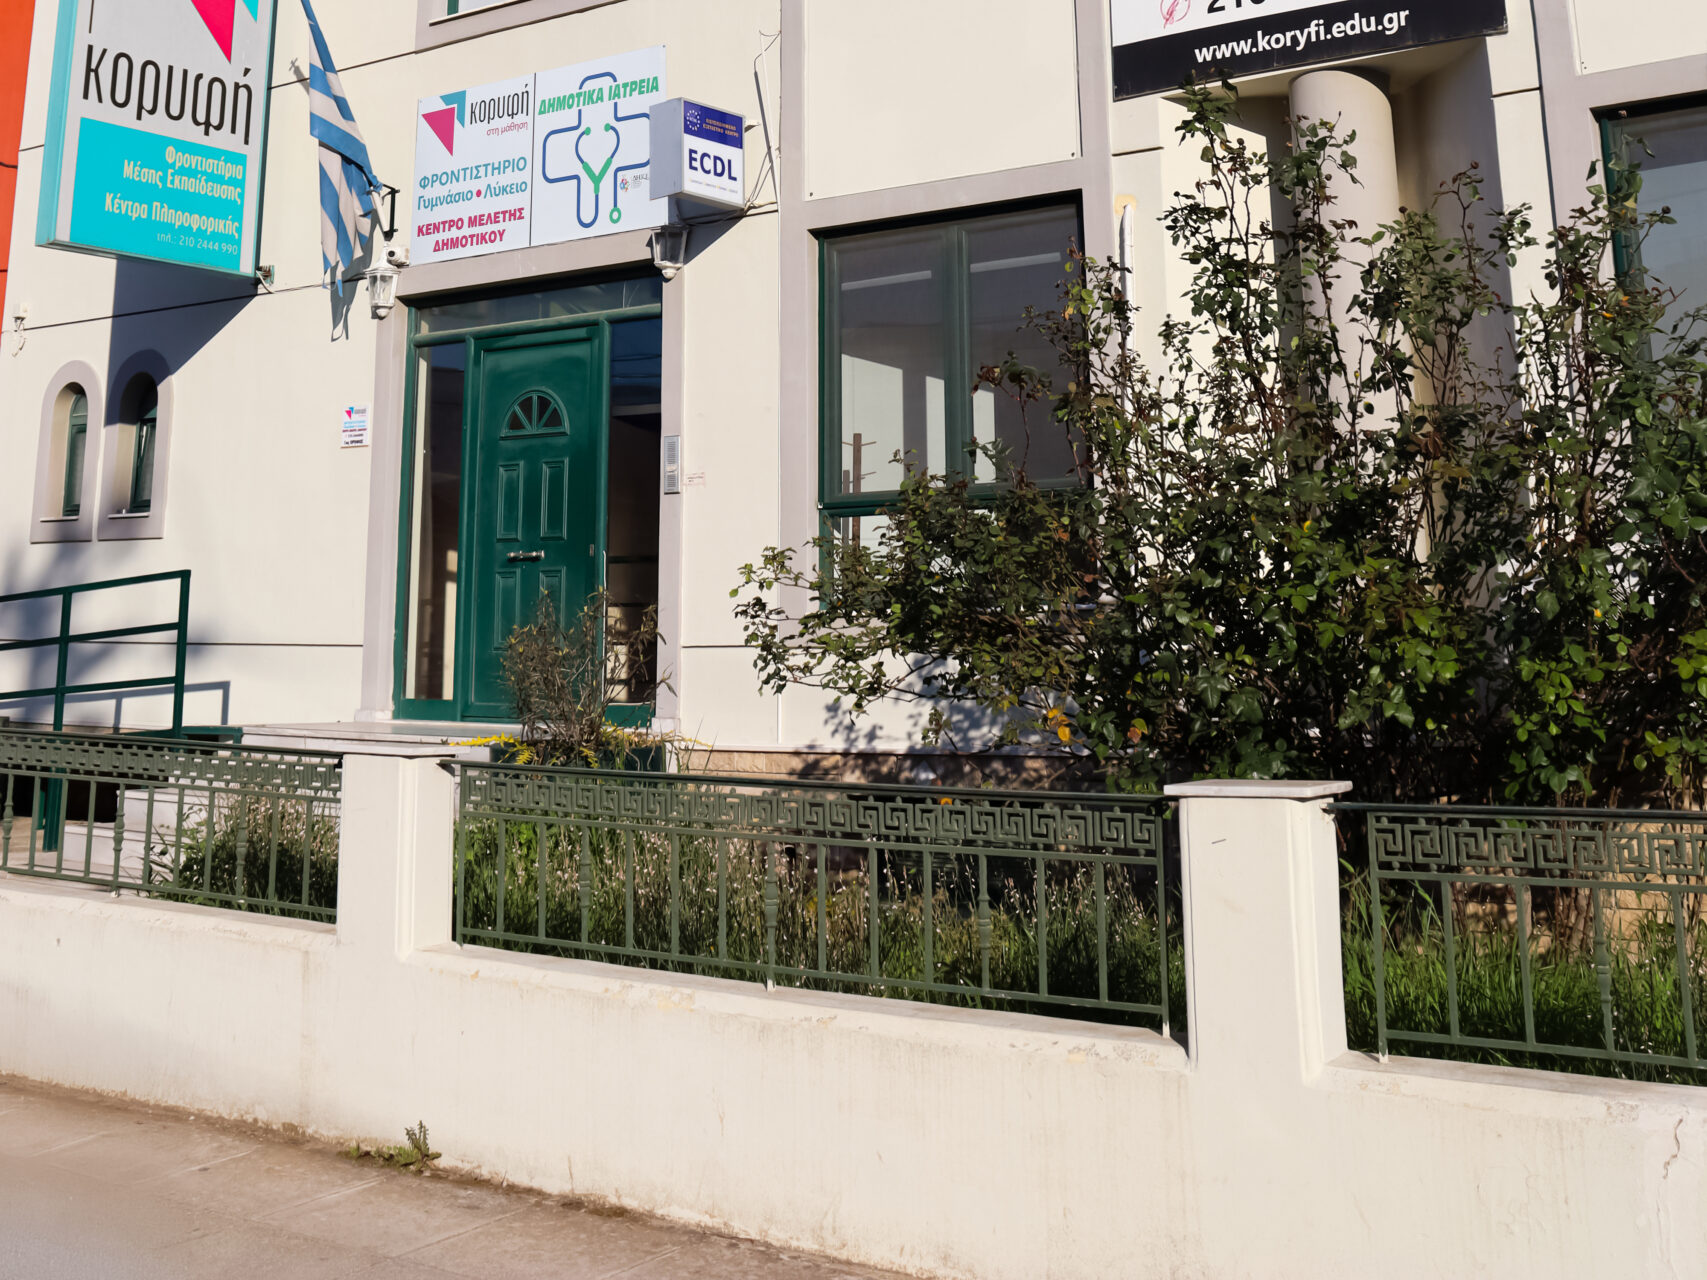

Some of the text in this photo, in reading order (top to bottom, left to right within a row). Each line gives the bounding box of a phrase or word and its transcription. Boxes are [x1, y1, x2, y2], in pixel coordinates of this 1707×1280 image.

[1194, 6, 1410, 64] www.koryfi.edu.gr
[82, 44, 254, 146] κορυφή
[469, 83, 530, 126] κορυφή
[537, 75, 660, 116] ΔΗΜΟΤΙΚΑ ΙΑΤΡΕΙΑ
[486, 121, 529, 137] στη μάθηση
[165, 145, 243, 181] Φροντιστήρια
[418, 156, 528, 191] ΦΡΟΝΤΙΣΤΗΡΙΟ
[688, 148, 738, 182] ECDL
[123, 159, 242, 205] Μέσης Εκπαίδευσης
[417, 180, 528, 212] Γυμνάσιο Λύκειο
[104, 192, 240, 240] Κέντρα Πληροφορικής
[416, 207, 525, 239] ΚΕΝΤΡΟ ΜΕΛΕΤΗΣ
[179, 235, 195, 248] 210
[197, 238, 219, 252] 2444
[221, 242, 238, 256] 990
[432, 228, 506, 253] ΔΗΜΟΤΙΚΟΥ
